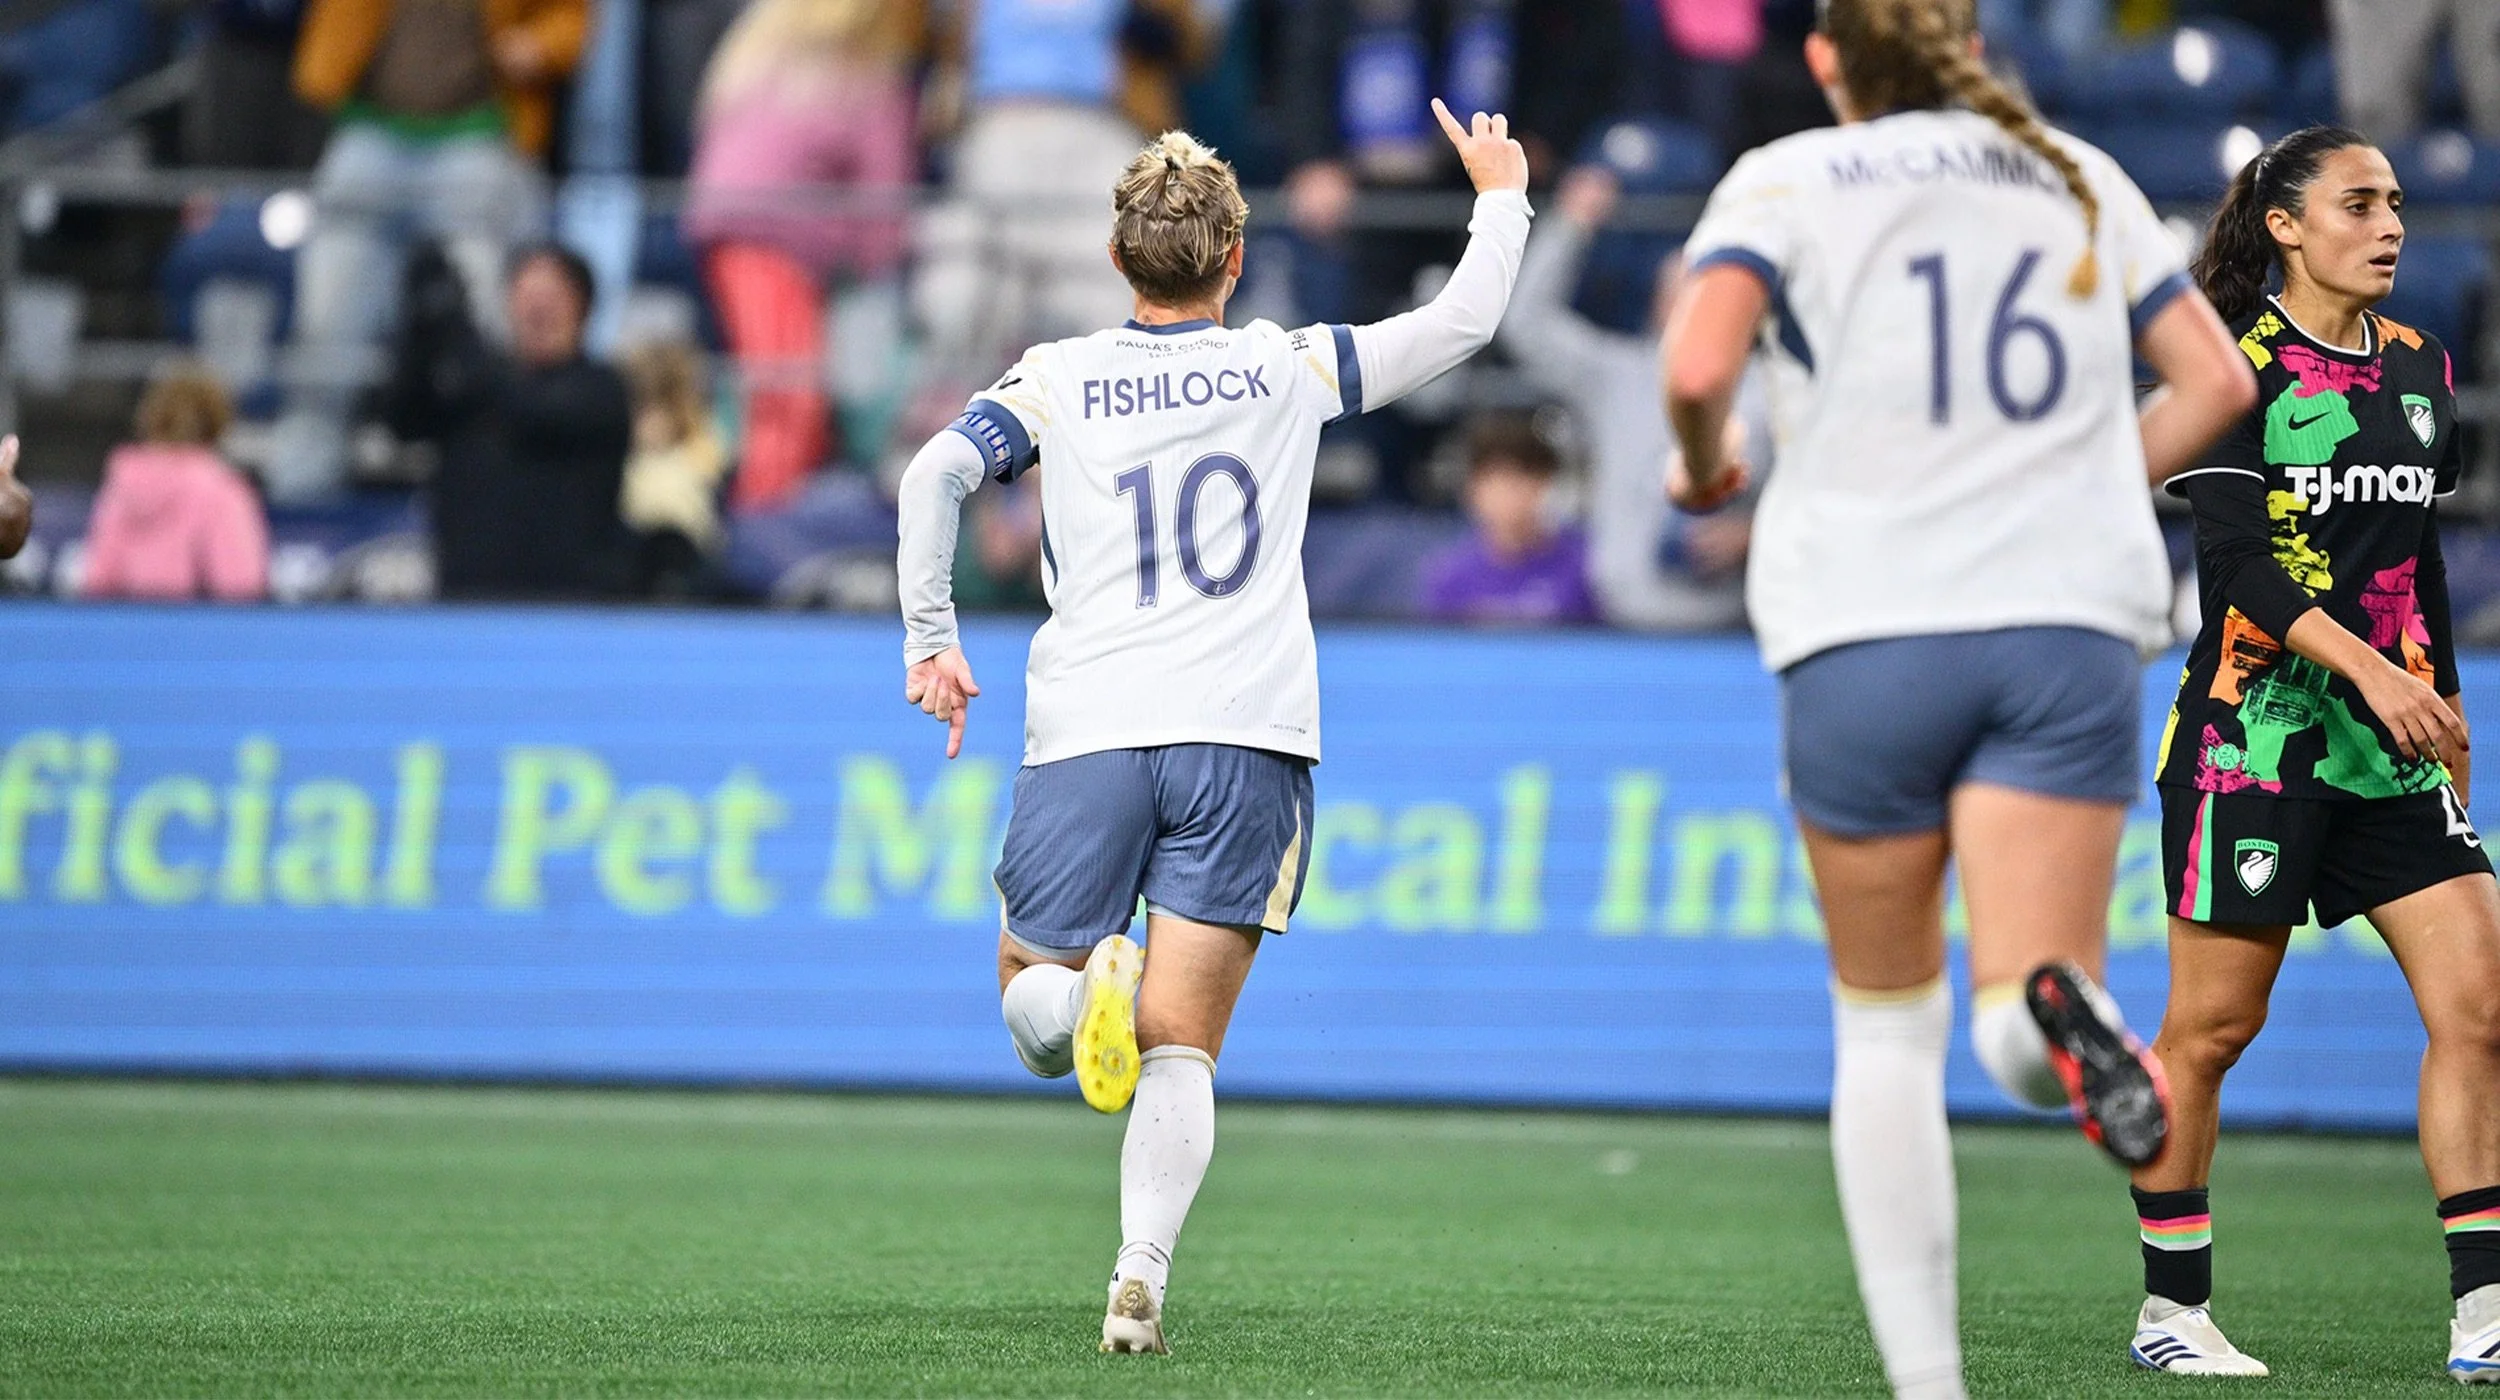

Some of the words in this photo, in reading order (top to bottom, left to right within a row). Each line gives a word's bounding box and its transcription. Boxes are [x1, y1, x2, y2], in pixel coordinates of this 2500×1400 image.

[1116, 340, 1172, 352] PAULA'S
[1907, 249, 2067, 424] 16
[1083, 364, 1271, 419] FISHLOCK
[1114, 451, 1264, 609] 10
[486, 745, 786, 917] Pet
[2237, 840, 2277, 851] BOSTON
